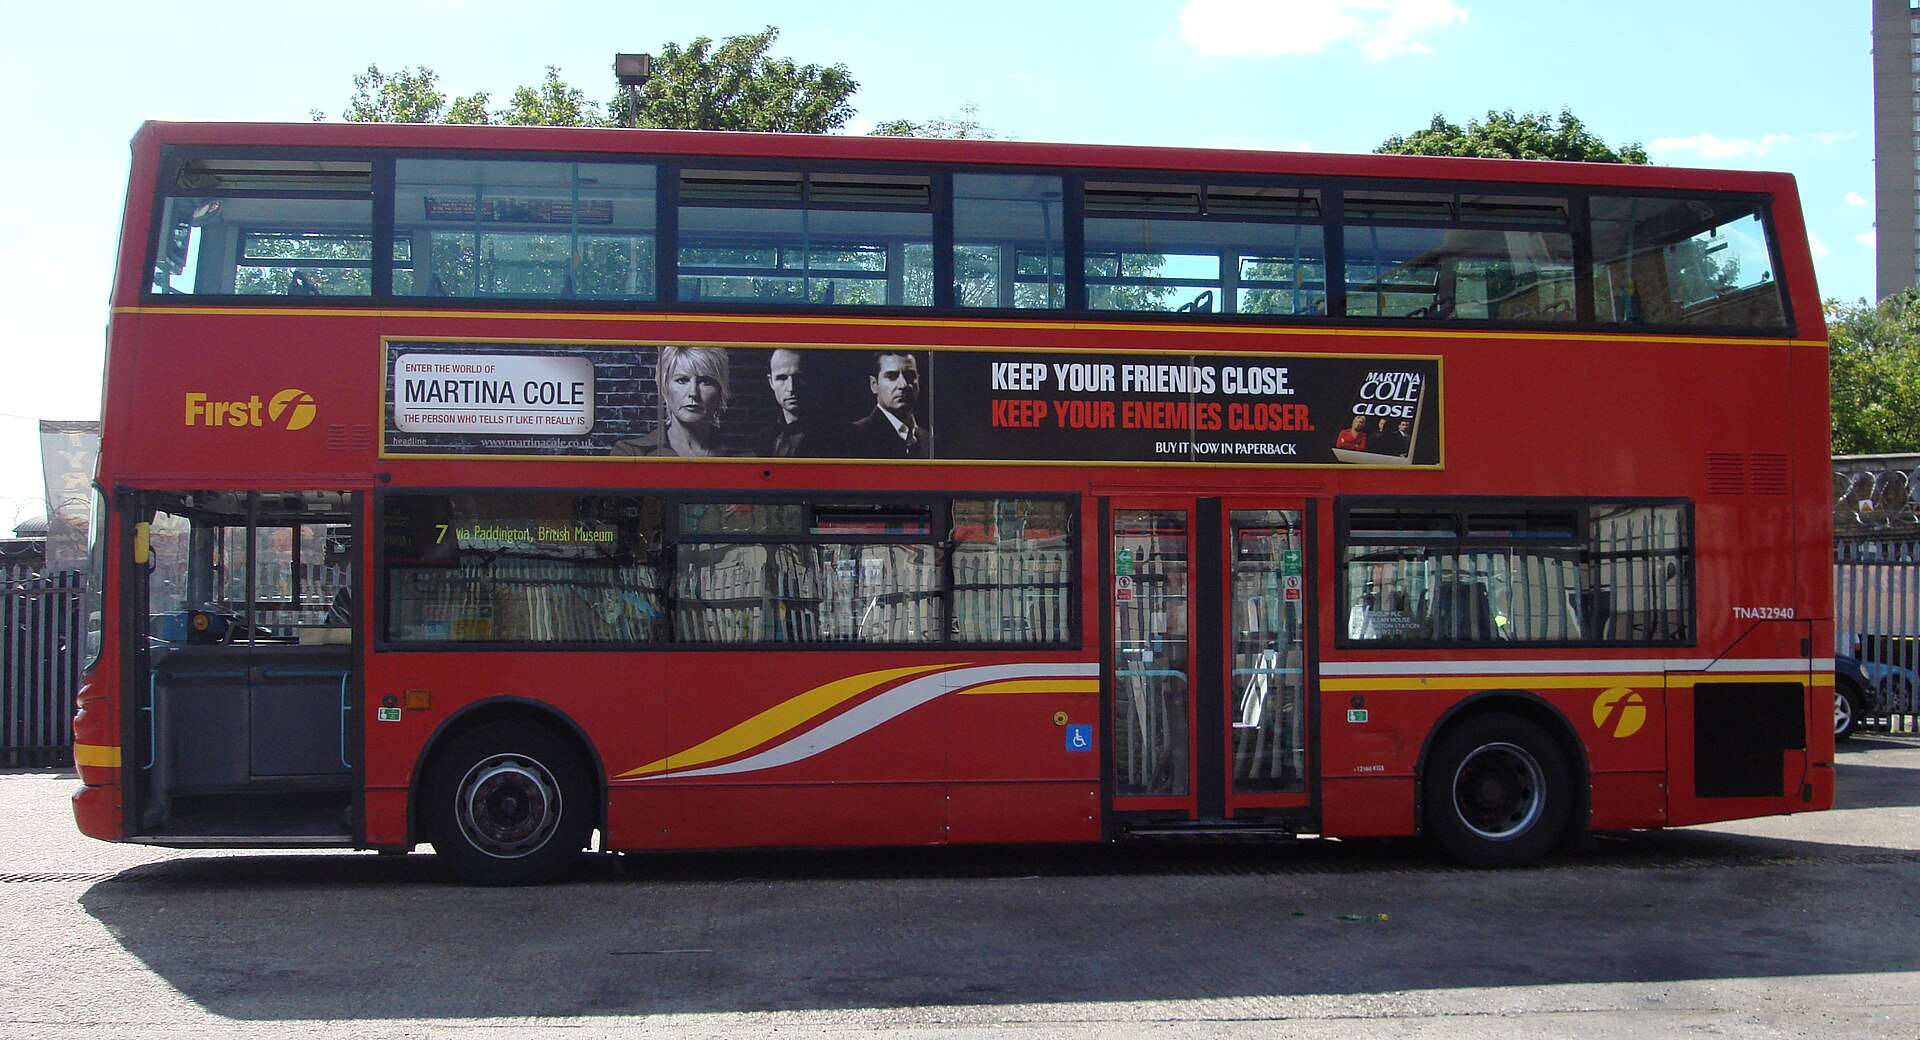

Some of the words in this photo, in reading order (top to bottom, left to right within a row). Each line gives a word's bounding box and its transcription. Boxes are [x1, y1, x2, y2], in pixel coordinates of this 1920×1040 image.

[405, 363, 432, 373] ENTER
[435, 364, 450, 373] THE
[452, 364, 482, 373] WORLD
[484, 365, 495, 373] OF
[992, 362, 1047, 391] KEEP
[1053, 363, 1116, 392] YOUR
[1122, 364, 1216, 394] FRIENDS
[1222, 366, 1294, 395] CLOSE.
[1365, 372, 1421, 383] MARTINA
[405, 379, 516, 404] MARTINA
[523, 381, 584, 405] COLE
[1359, 380, 1420, 402] COLE
[185, 392, 262, 427] First
[992, 399, 1047, 428] KEEP
[1053, 400, 1116, 429] YOUR
[1122, 401, 1222, 430] ENEMIES
[1228, 402, 1315, 431] CLOSER.
[1352, 403, 1414, 419] CLOSE
[404, 414, 419, 423] THE
[422, 414, 455, 423] PERSON
[457, 415, 477, 423] WHO
[479, 415, 504, 424] TELLS
[506, 416, 514, 424] IT
[516, 416, 533, 424] LIKE
[536, 416, 543, 424] IT
[545, 416, 575, 425] REALLY
[577, 416, 585, 425] IS
[393, 437, 427, 445] headline
[480, 437, 595, 448] www.martinacole.co.uk
[1155, 441, 1177, 453] BUY
[1178, 442, 1189, 453] IT
[1191, 442, 1219, 454] NOW
[1221, 443, 1233, 454] IN
[1235, 443, 1297, 455] PAPERBACK
[435, 524, 449, 544] 7
[456, 526, 470, 540] via
[474, 525, 534, 544] Paddington,
[538, 526, 570, 541] British
[574, 526, 613, 542] Museum
[1732, 607, 1794, 619] TNA32940
